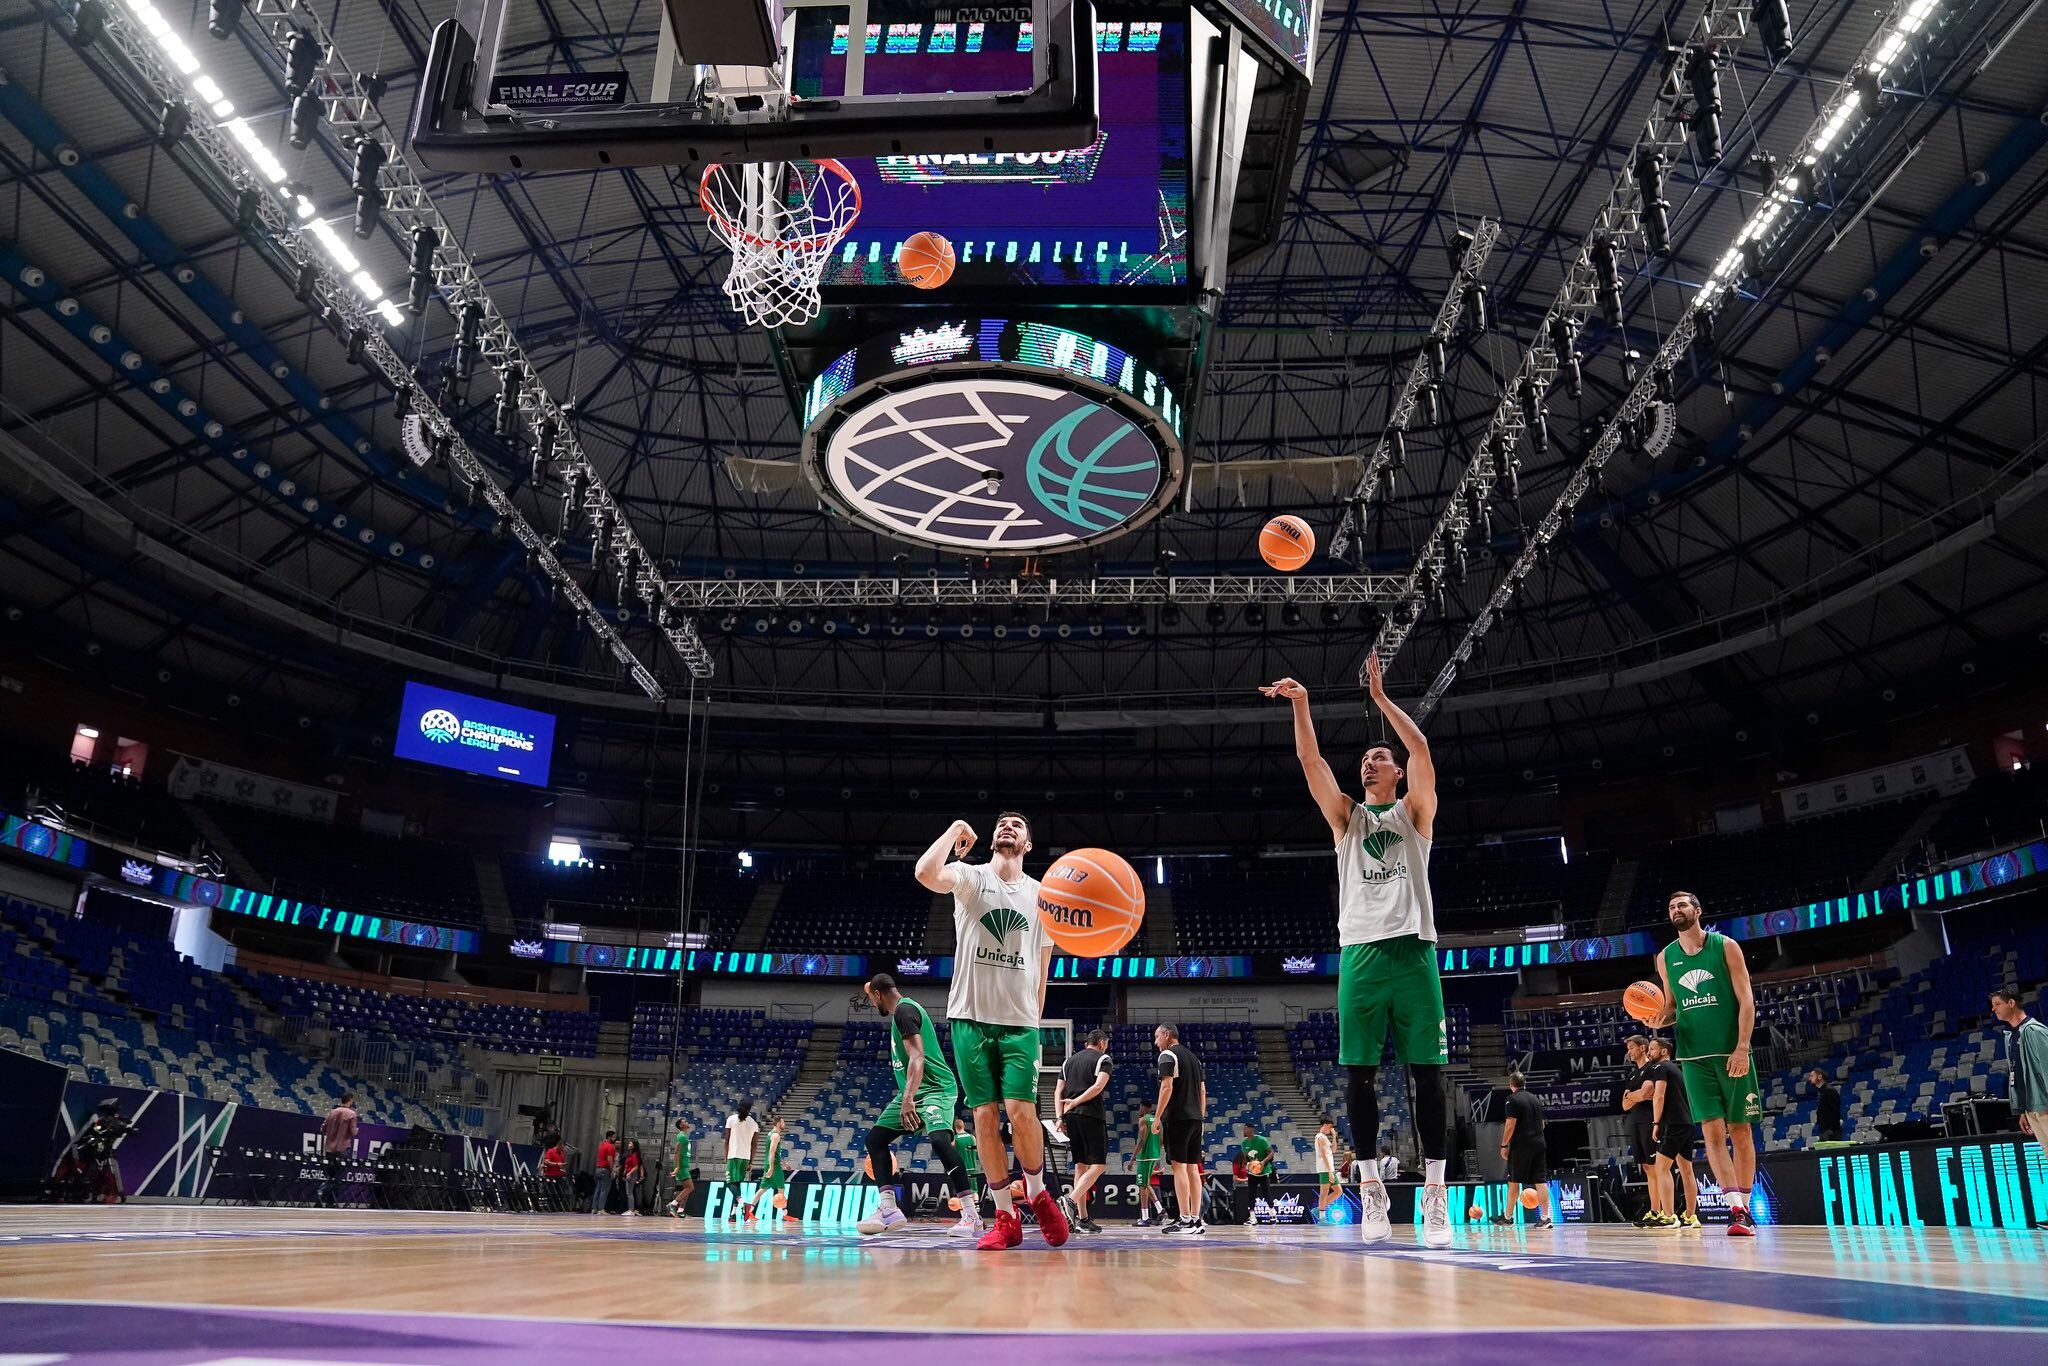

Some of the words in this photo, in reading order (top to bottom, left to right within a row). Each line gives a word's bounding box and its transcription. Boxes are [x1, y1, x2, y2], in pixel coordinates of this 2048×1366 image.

[956, 7, 1032, 23] MOND
[499, 85, 558, 100] FINAL
[562, 82, 619, 97] FOUR
[842, 241, 1128, 263] #BAETBALLCL
[461, 727, 534, 752] CHAMPIONS
[463, 719, 526, 740] BASKETBALL
[460, 737, 500, 752] LEAGUE
[1362, 861, 1407, 880] Unicaja
[1808, 889, 1884, 929] FINAL
[1900, 869, 1963, 909] FOUR
[230, 887, 303, 925] FINAL
[318, 907, 382, 939] FOUR
[1037, 895, 1094, 928] Wilson
[626, 946, 696, 971] FINAL
[713, 951, 773, 973] FOUR
[976, 946, 1025, 967] Unicaja
[1489, 943, 1549, 968] FOUR
[1097, 957, 1156, 978] FOUR
[1681, 992, 1718, 1007] Unicaja
[1573, 1088, 1612, 1104] FOUR
[1819, 1151, 1925, 1228] FINAL
[1278, 1205, 1305, 1214] FOUR
[1696, 1194, 1716, 1207] FINAL
